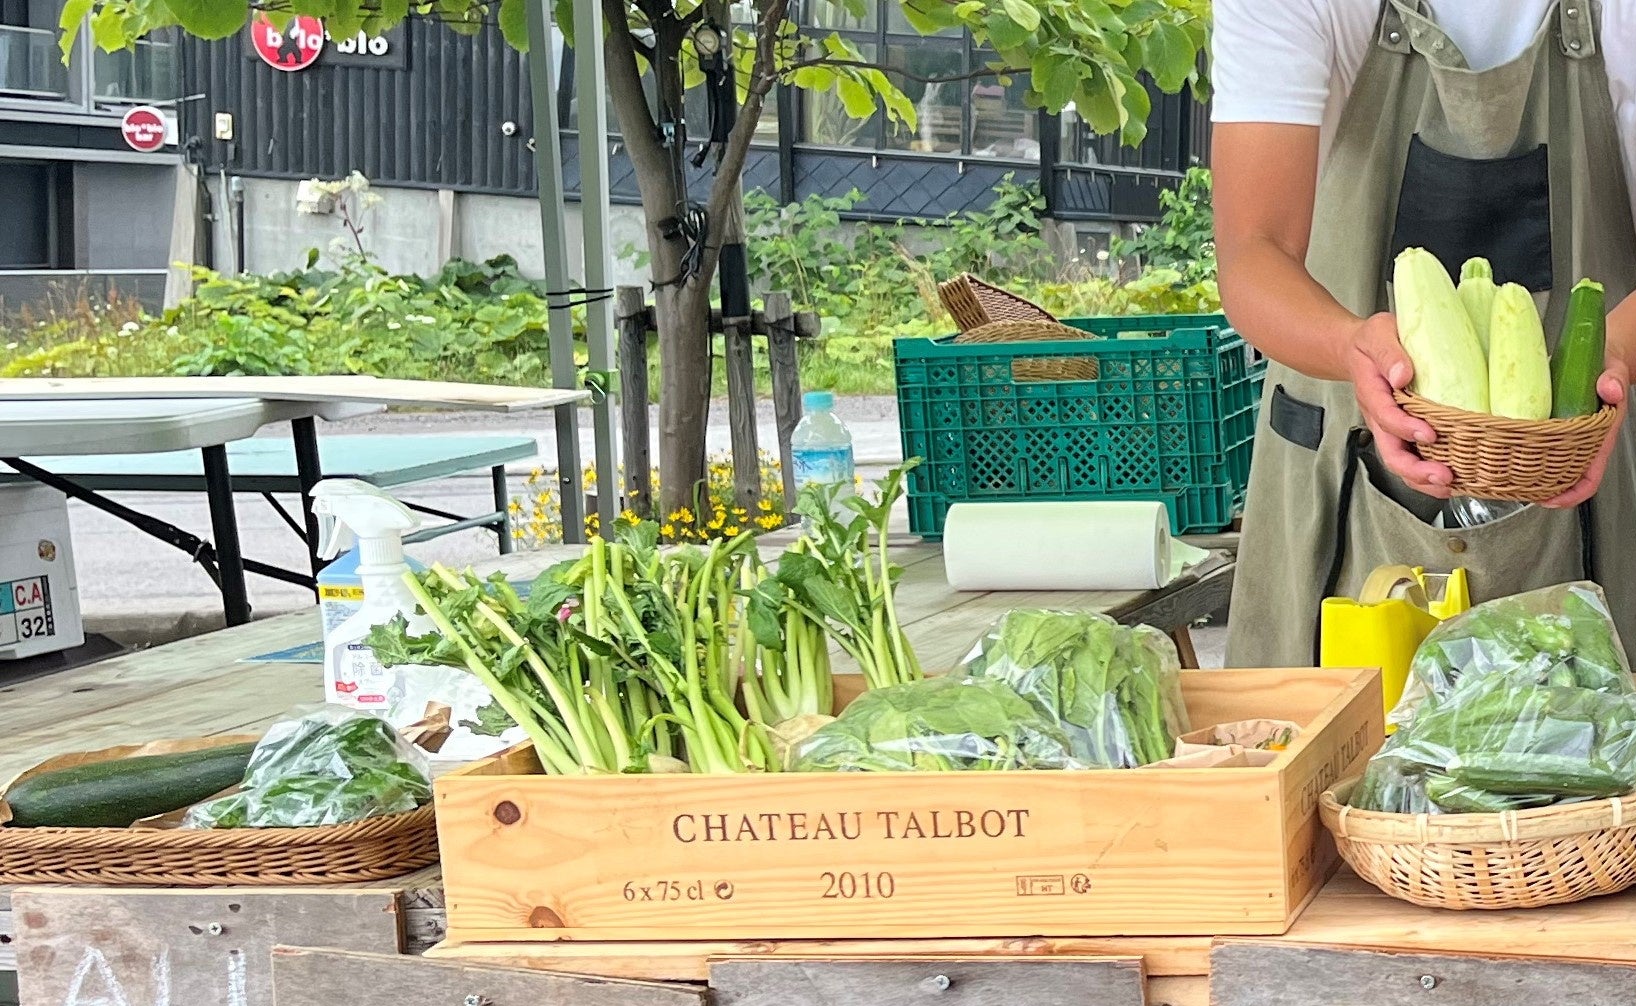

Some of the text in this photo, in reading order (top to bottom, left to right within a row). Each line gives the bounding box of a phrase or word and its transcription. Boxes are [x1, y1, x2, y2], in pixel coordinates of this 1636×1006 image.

[21, 616, 46, 638] 32
[673, 809, 1030, 843] CHATEAU TALBOT
[623, 879, 704, 901] 6 x 75 cl
[820, 871, 896, 899] 2010
